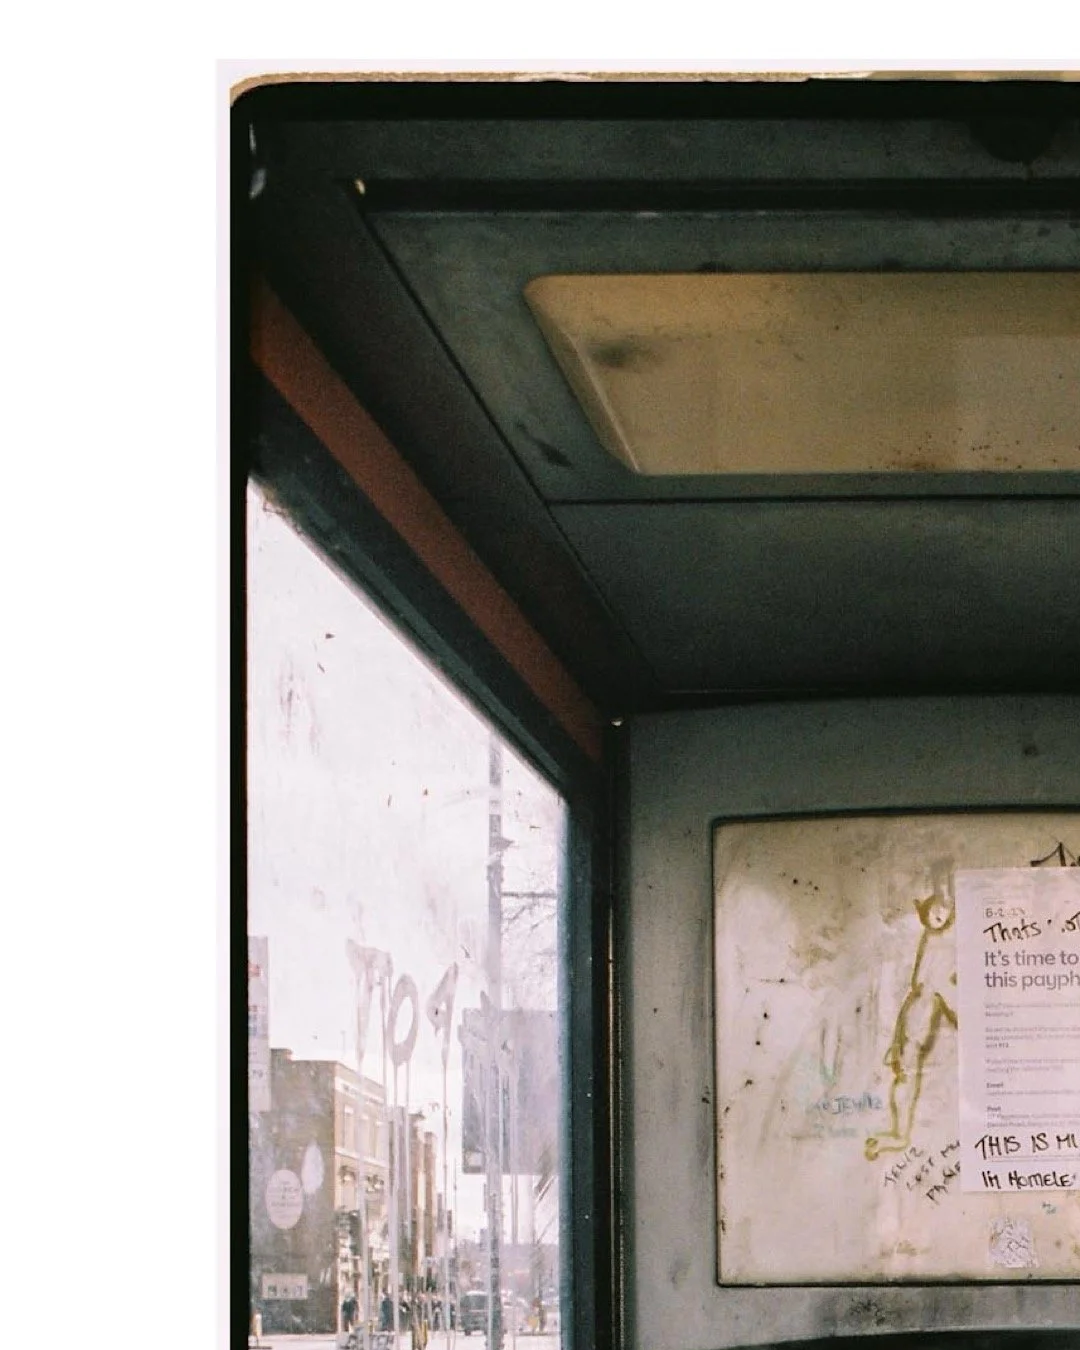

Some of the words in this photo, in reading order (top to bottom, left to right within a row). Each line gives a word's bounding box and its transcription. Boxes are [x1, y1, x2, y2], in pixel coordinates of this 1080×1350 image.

[984, 950, 1010, 967] It's
[1015, 951, 1056, 967] time
[1060, 950, 1079, 967] to
[984, 971, 1018, 988] this
[974, 1133, 1022, 1161] THIS
[1031, 1131, 1050, 1154] IS
